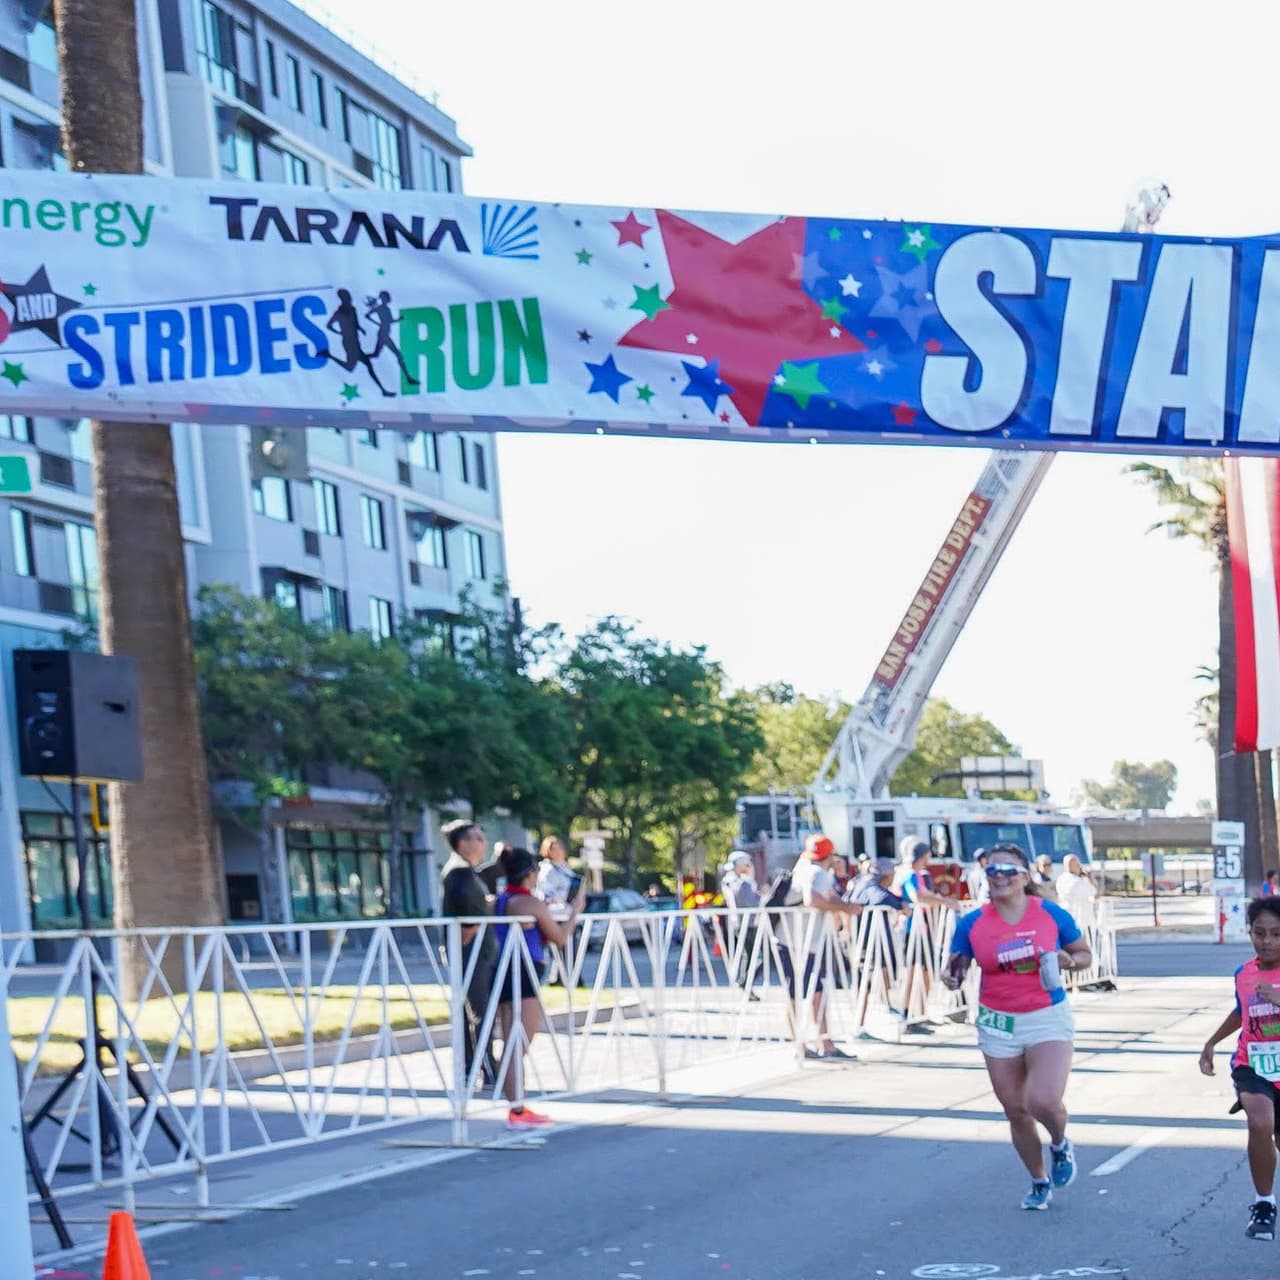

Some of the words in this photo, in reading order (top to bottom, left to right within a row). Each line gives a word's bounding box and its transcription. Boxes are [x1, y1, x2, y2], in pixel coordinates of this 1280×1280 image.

[2, 198, 155, 247] nergy
[208, 196, 471, 254] TARANA
[15, 292, 58, 323] AND
[63, 294, 330, 390] STRIDES
[402, 297, 549, 396] RUN
[876, 643, 906, 681] SAN
[897, 593, 932, 642] JOSE
[922, 547, 958, 597] FIRE
